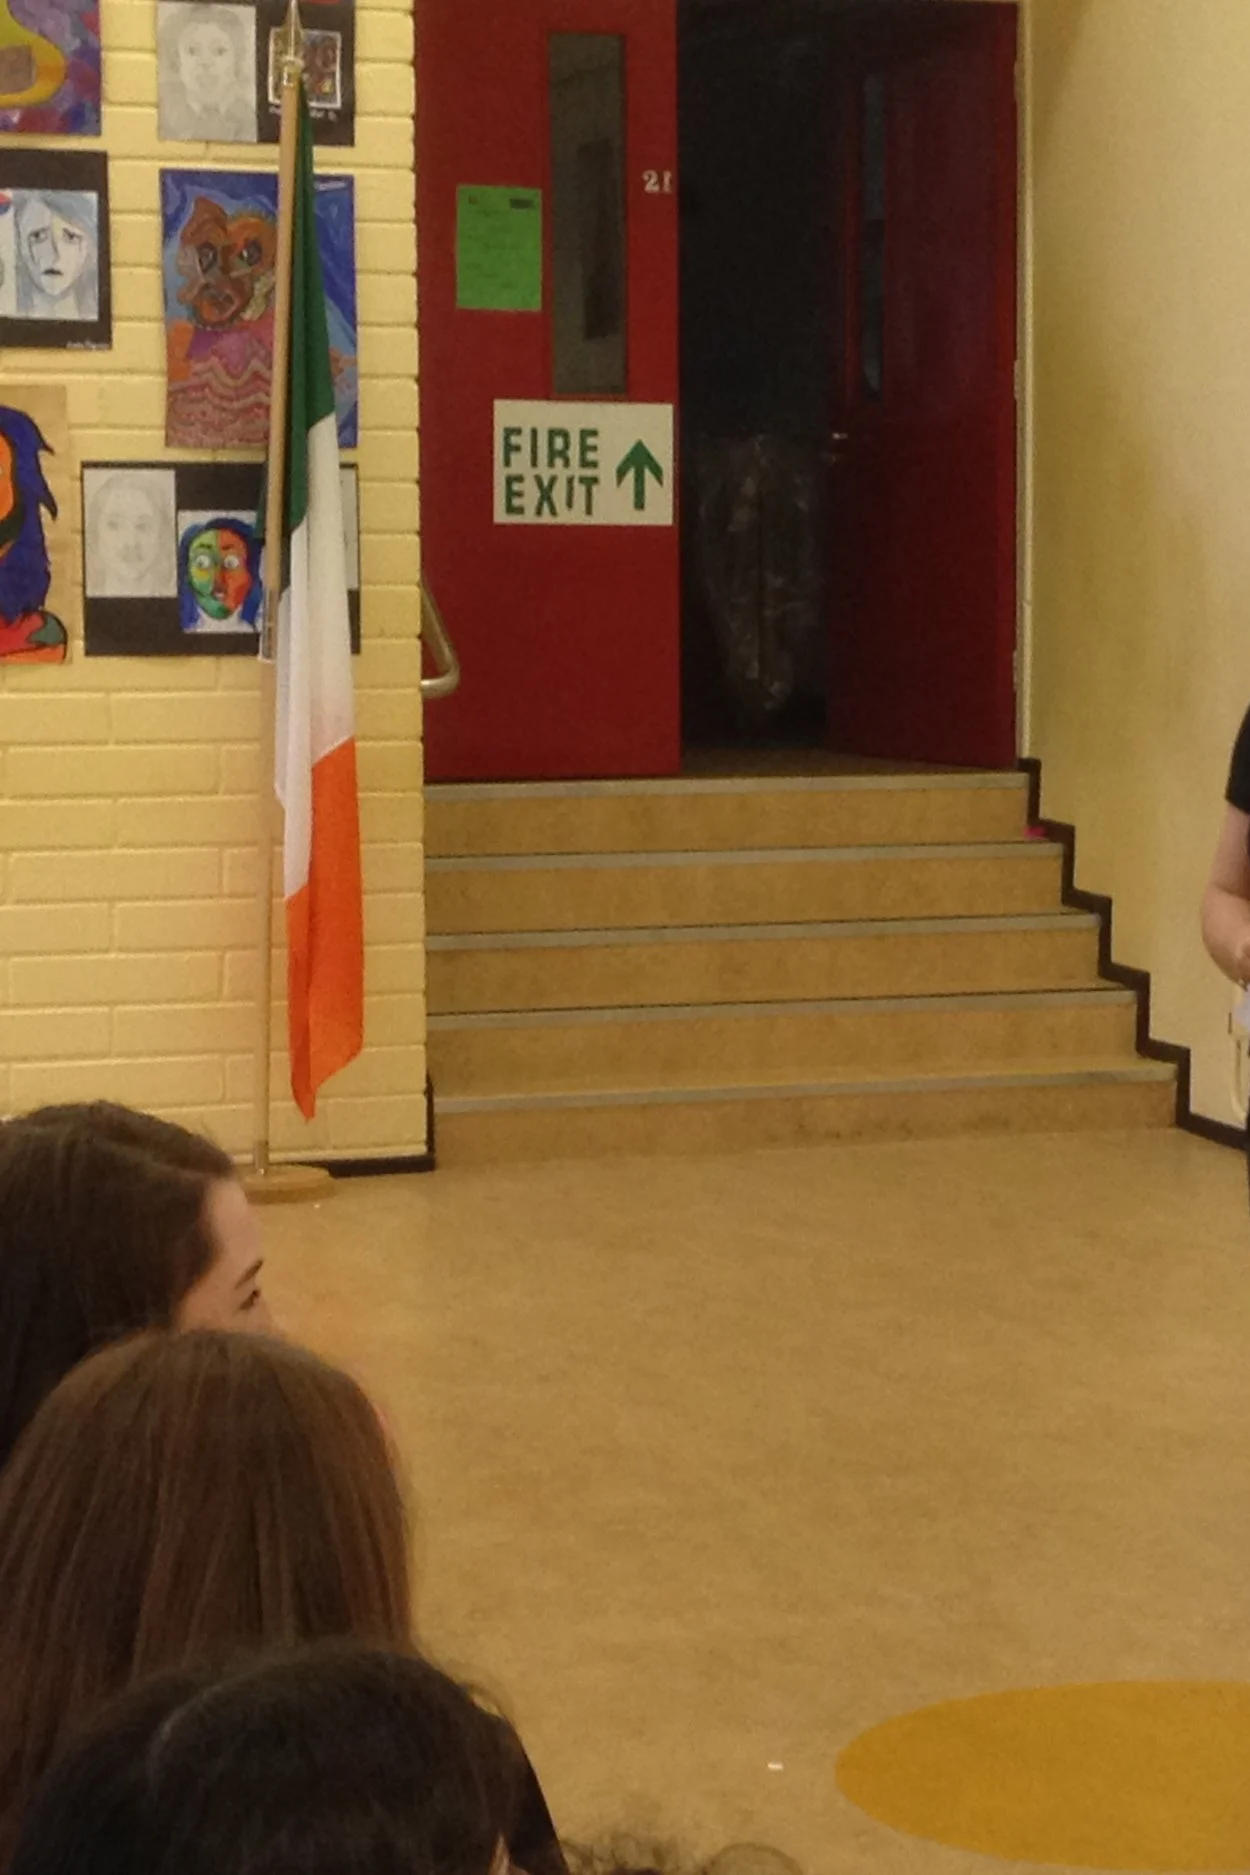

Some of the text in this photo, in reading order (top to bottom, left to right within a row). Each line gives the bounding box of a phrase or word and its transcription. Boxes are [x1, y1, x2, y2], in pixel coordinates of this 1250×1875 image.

[642, 169, 673, 194] 21
[503, 427, 598, 469] FIRE
[504, 474, 599, 517] EXIT
